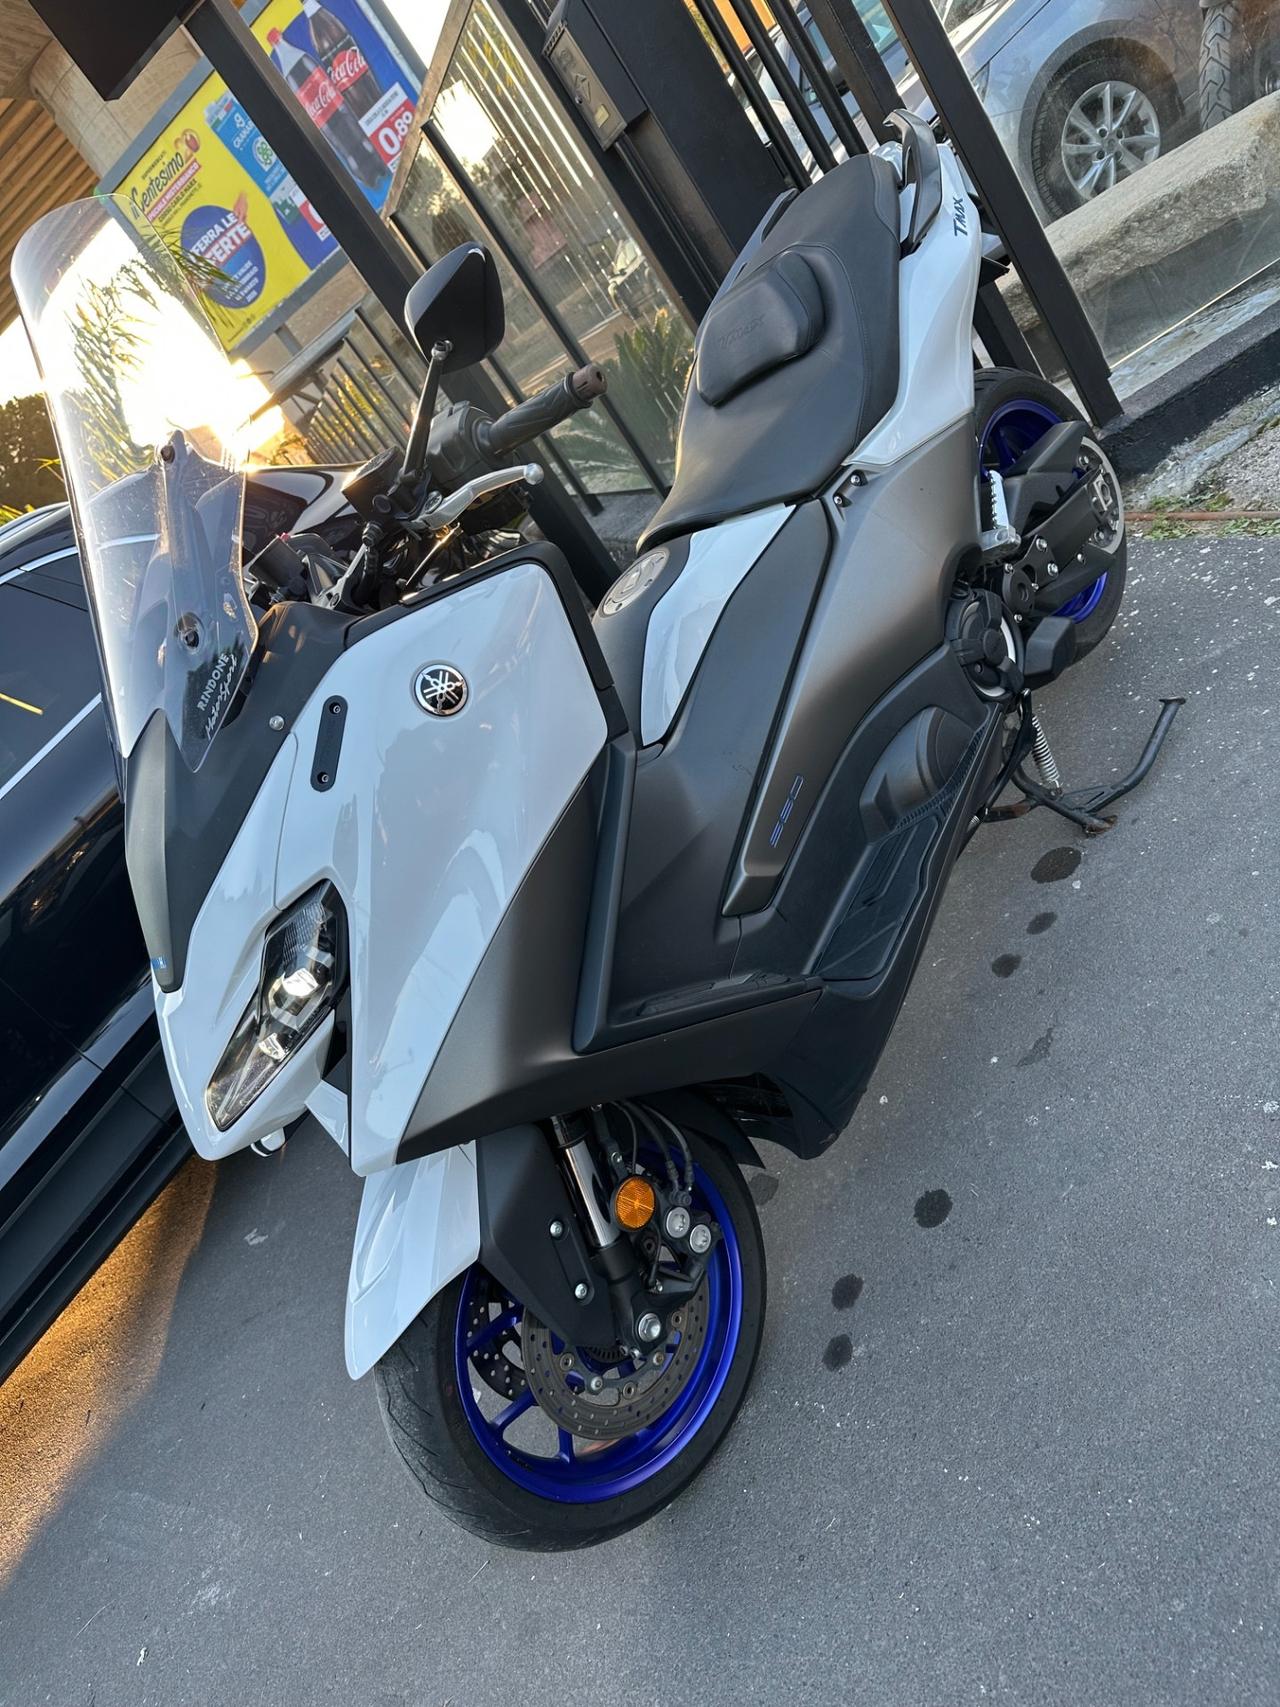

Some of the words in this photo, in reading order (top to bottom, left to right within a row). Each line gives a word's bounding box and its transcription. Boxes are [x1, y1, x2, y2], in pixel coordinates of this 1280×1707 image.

[307, 80, 336, 119] oca-Cola
[131, 151, 184, 213] Centesimo
[188, 223, 225, 257] FERRA
[221, 211, 238, 227] LE
[953, 196, 968, 237] TMAX
[203, 222, 251, 266] FERTE
[197, 653, 229, 711] RINDONE
